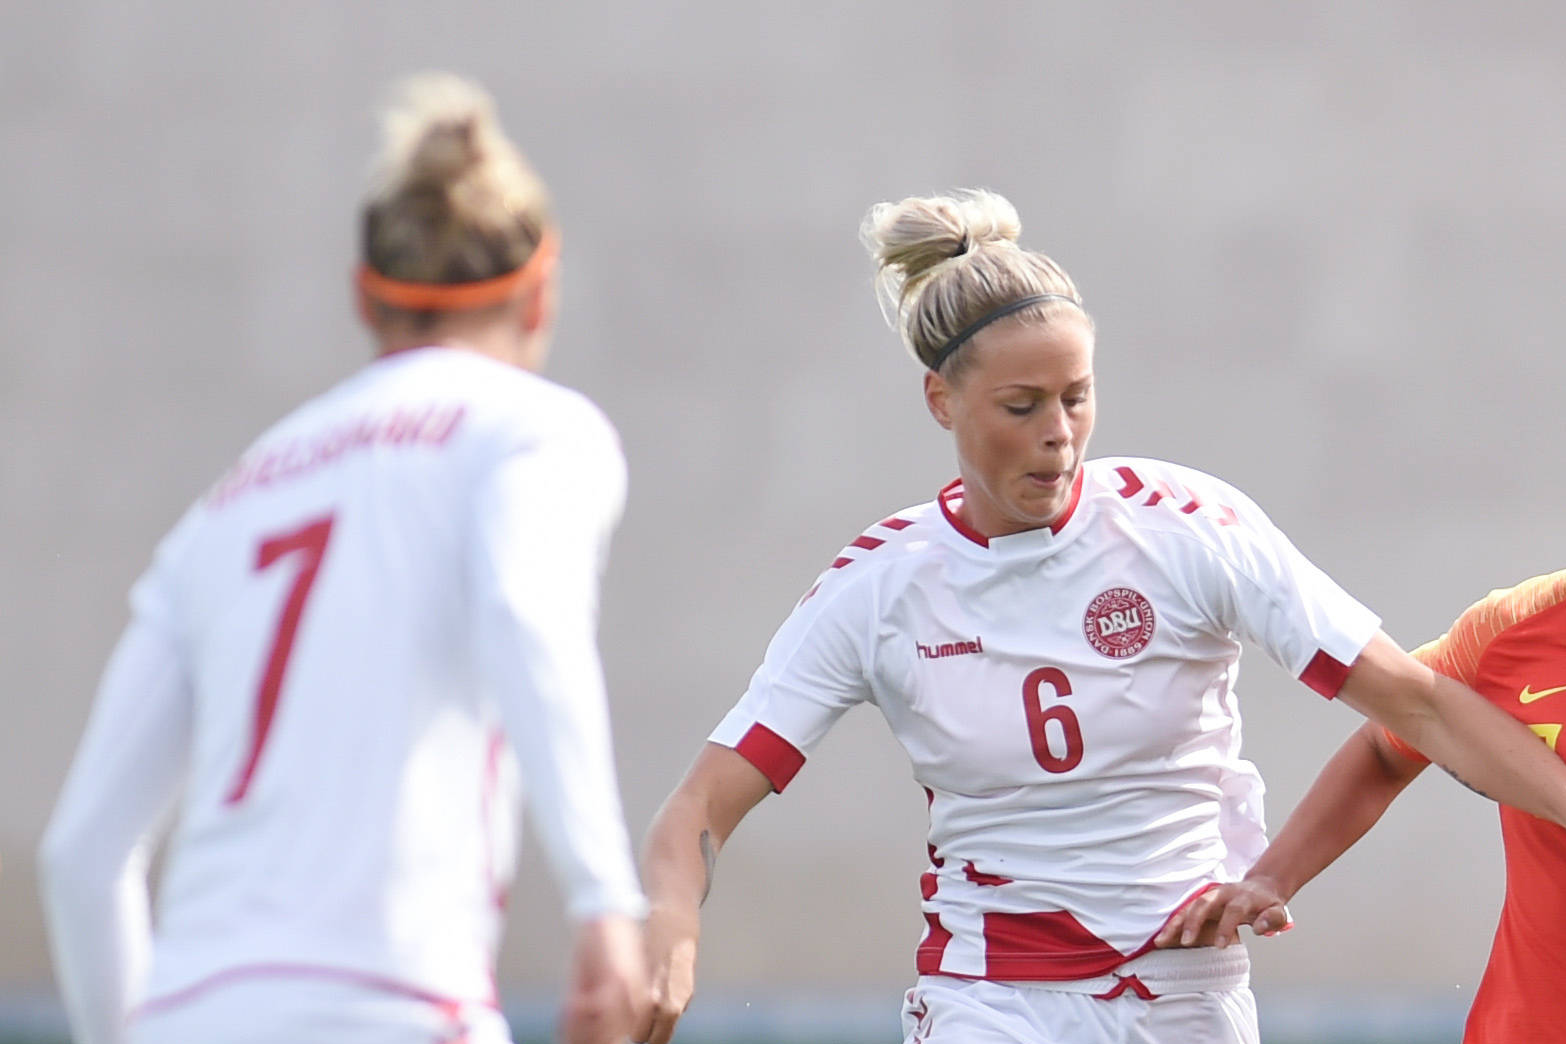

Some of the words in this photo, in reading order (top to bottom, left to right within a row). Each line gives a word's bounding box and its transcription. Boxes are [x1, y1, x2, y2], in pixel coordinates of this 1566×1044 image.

[915, 635, 984, 660] hummel
[1097, 607, 1142, 637] DBU
[222, 510, 337, 807] 7
[1021, 666, 1085, 774] 6
